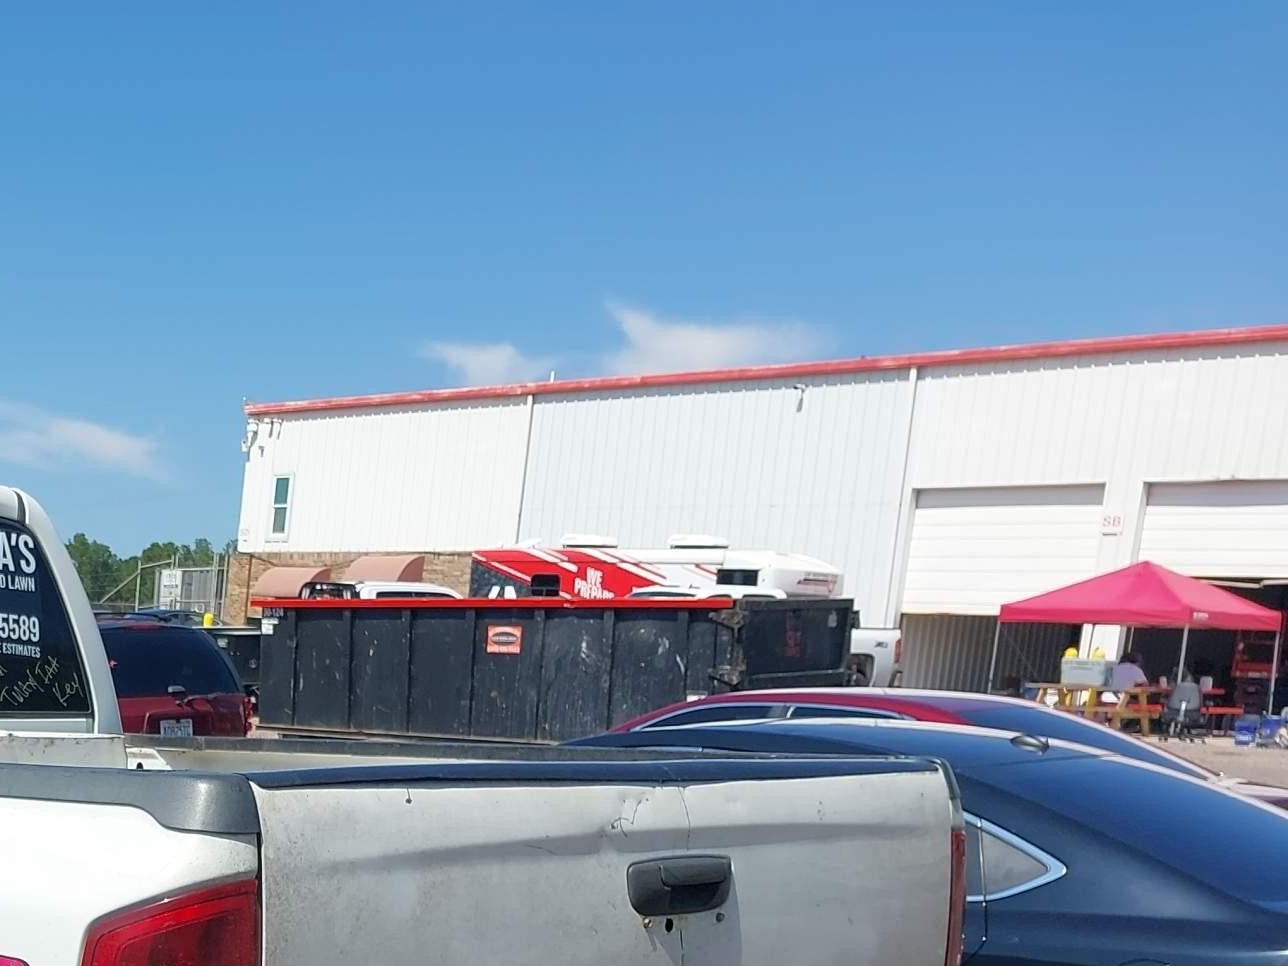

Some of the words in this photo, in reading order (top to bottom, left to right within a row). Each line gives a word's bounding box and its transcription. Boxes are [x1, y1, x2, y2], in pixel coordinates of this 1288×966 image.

[8, 575, 36, 592] LAWN
[587, 566, 604, 587] WE
[3, 644, 41, 658] ESTIMATES
